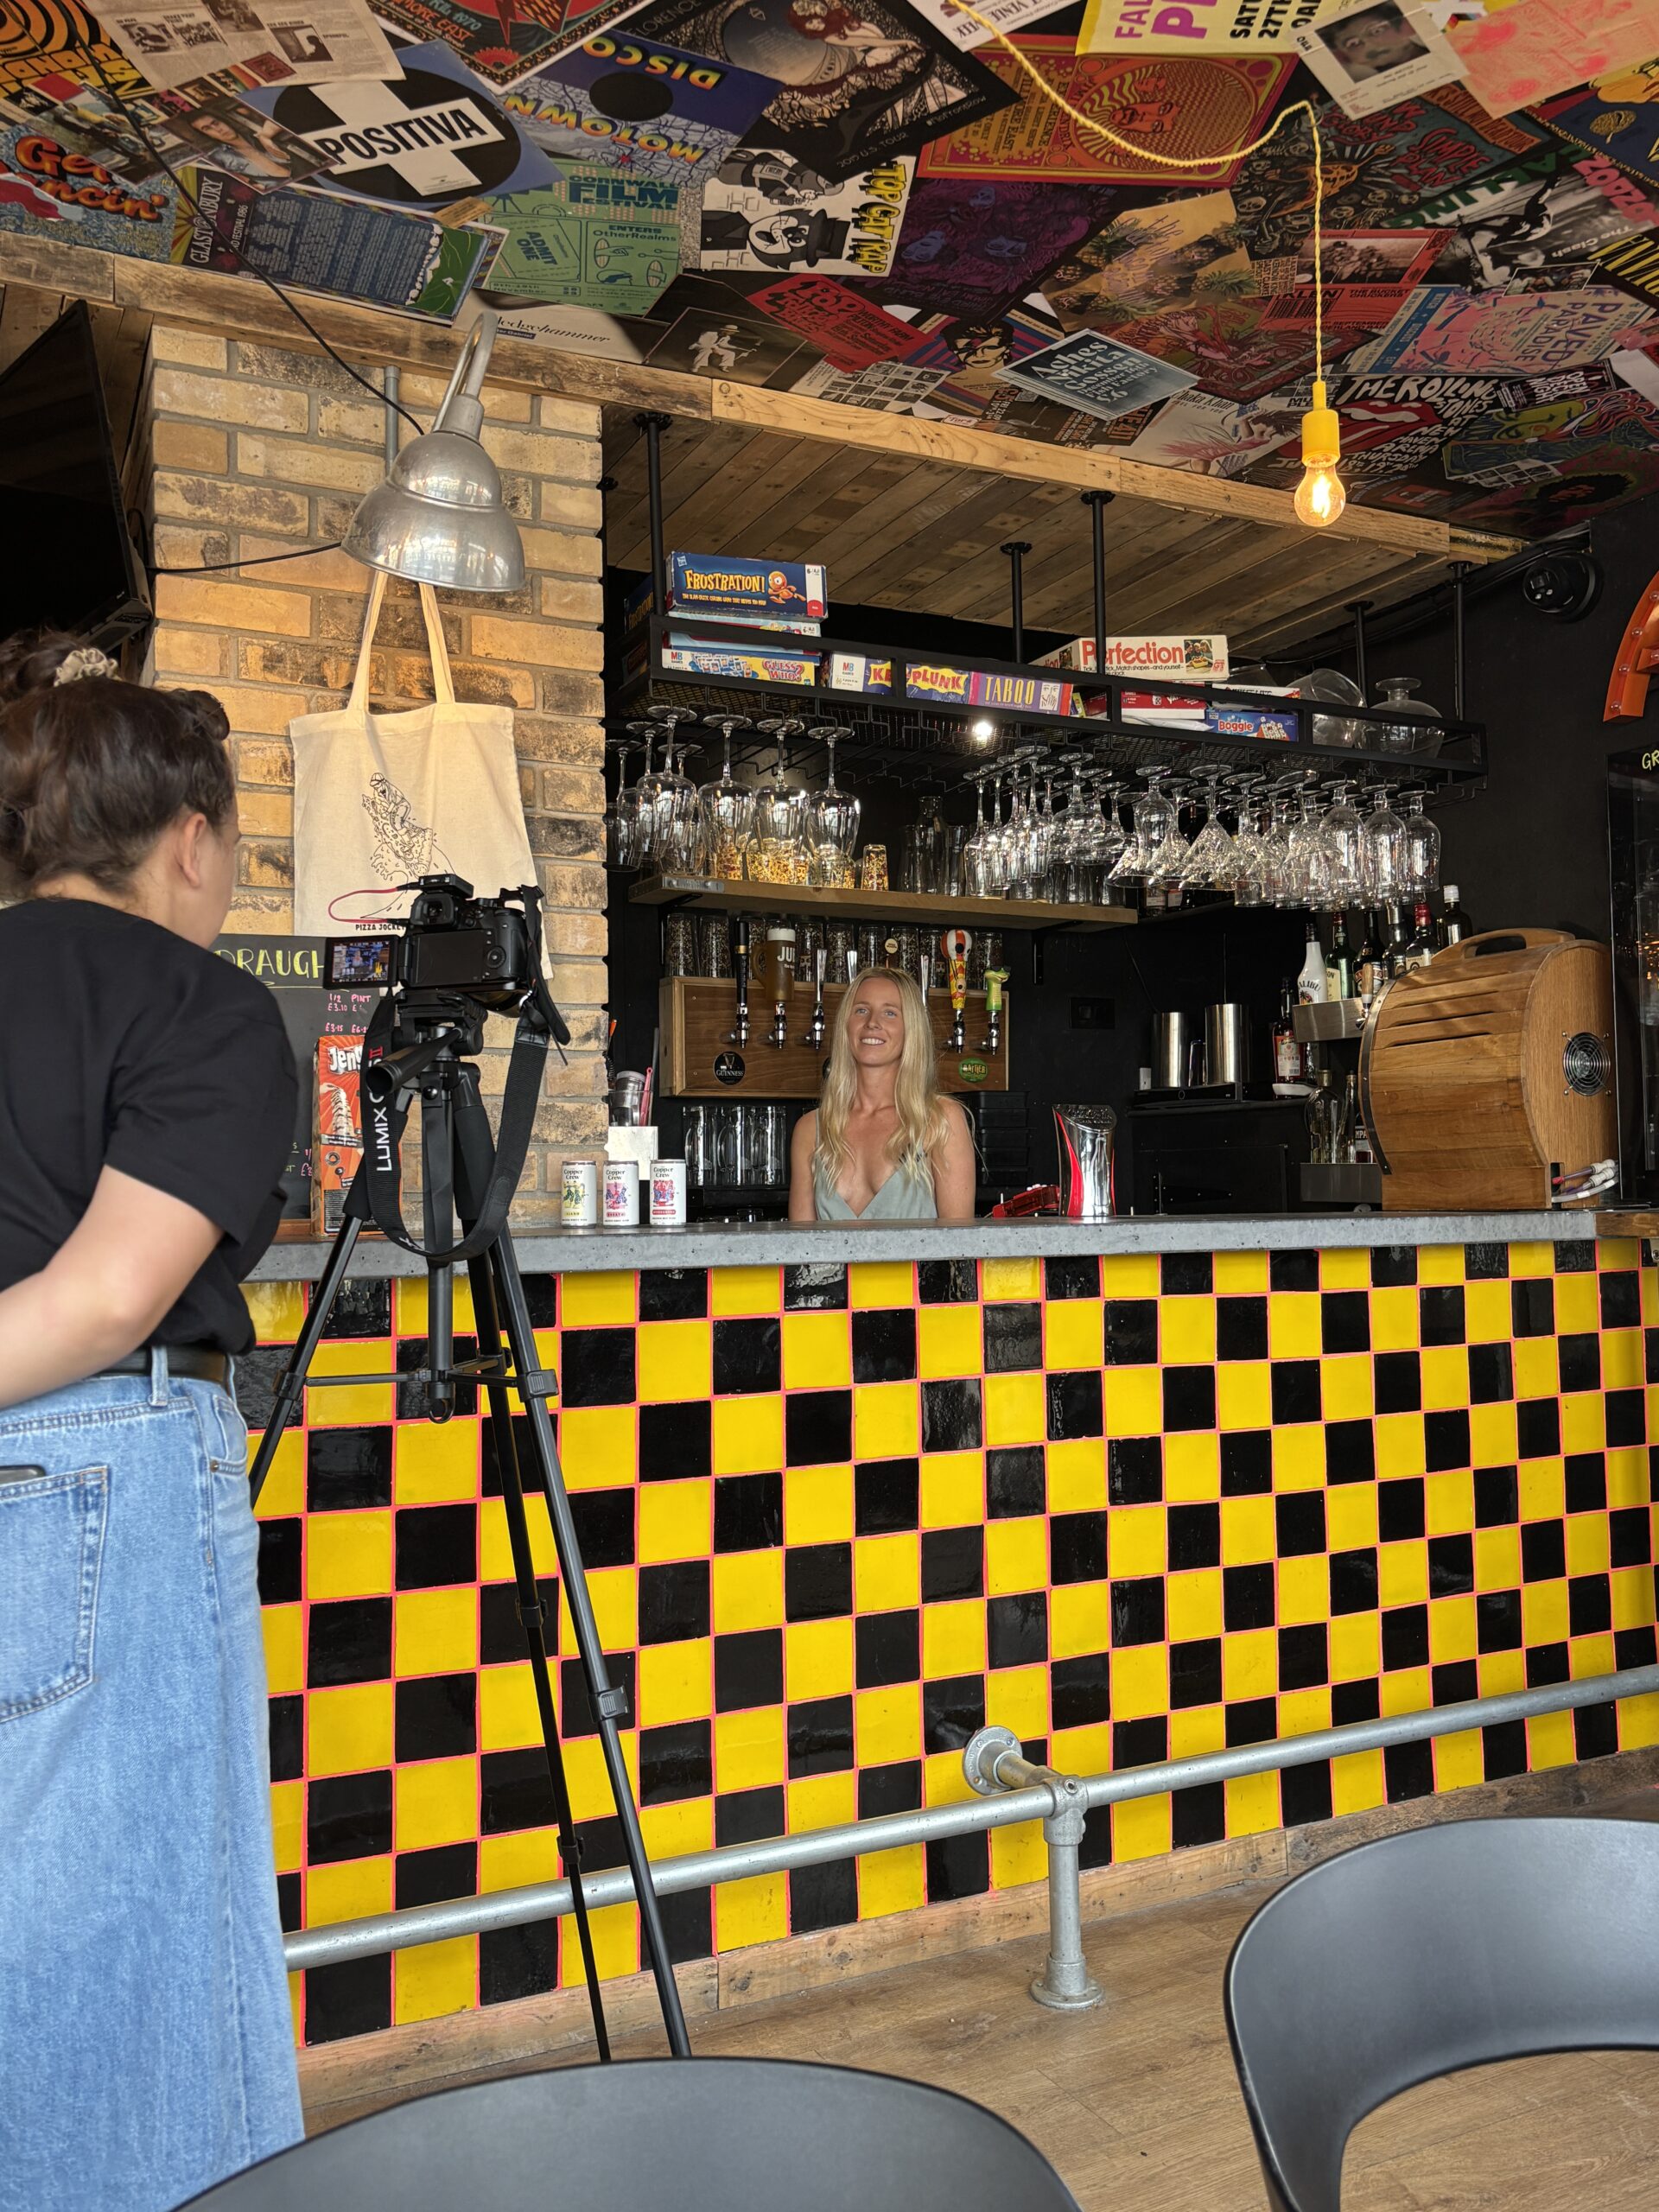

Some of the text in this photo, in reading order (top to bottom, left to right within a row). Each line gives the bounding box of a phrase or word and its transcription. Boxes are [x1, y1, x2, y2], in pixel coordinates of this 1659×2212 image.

[436, 18, 474, 41] EAST
[582, 34, 728, 92] DISCO
[1037, 81, 1069, 148] EXERIENCE
[317, 109, 486, 167] POSITIVA
[502, 92, 708, 163] MOTOWN
[569, 175, 678, 189] CORNWALL
[569, 181, 679, 205] FILM
[864, 162, 907, 204] TOP
[607, 224, 664, 235] ENTERS
[858, 204, 901, 240] CAT
[517, 238, 540, 262] ONE
[525, 231, 559, 266] ADMIT
[1551, 225, 1633, 258] The Clash
[854, 240, 892, 274] RAP
[496, 315, 612, 344] ledgehammer
[1512, 302, 1587, 363] PARADISE
[1543, 302, 1624, 364] PAVED
[1030, 341, 1109, 380] Aches
[1045, 349, 1128, 386] Nikita
[1064, 356, 1143, 391] Gossen
[1114, 365, 1160, 389] Factory
[1546, 374, 1570, 398] DECK
[1564, 371, 1589, 394] OPEN
[1203, 395, 1236, 410] Khan
[1336, 375, 1500, 405] THE ROLLING
[1525, 377, 1553, 404] NIGHT
[1434, 396, 1494, 420] STONES
[1409, 423, 1462, 437] NEW
[1446, 416, 1477, 428] AT
[1372, 442, 1440, 455] ARENA
[1389, 434, 1449, 446] HAVEN
[1346, 450, 1429, 464] THURSDAY
[683, 568, 766, 594] FRUSTRATION!
[671, 651, 683, 660] MB
[1081, 640, 1185, 666] Prfection
[762, 659, 793, 673] GUESS
[768, 664, 804, 683] WHO?
[842, 662, 855, 671] MB
[912, 668, 966, 692] PLUNK
[985, 676, 1036, 706] TABOO
[1217, 720, 1255, 733] Boggle
[213, 948, 325, 979] DRAUGH
[351, 994, 372, 1003] PINT
[327, 1044, 364, 1075] Jeng
[715, 1069, 744, 1077] GUINNESS
[372, 1107, 393, 1173] LUMIX
